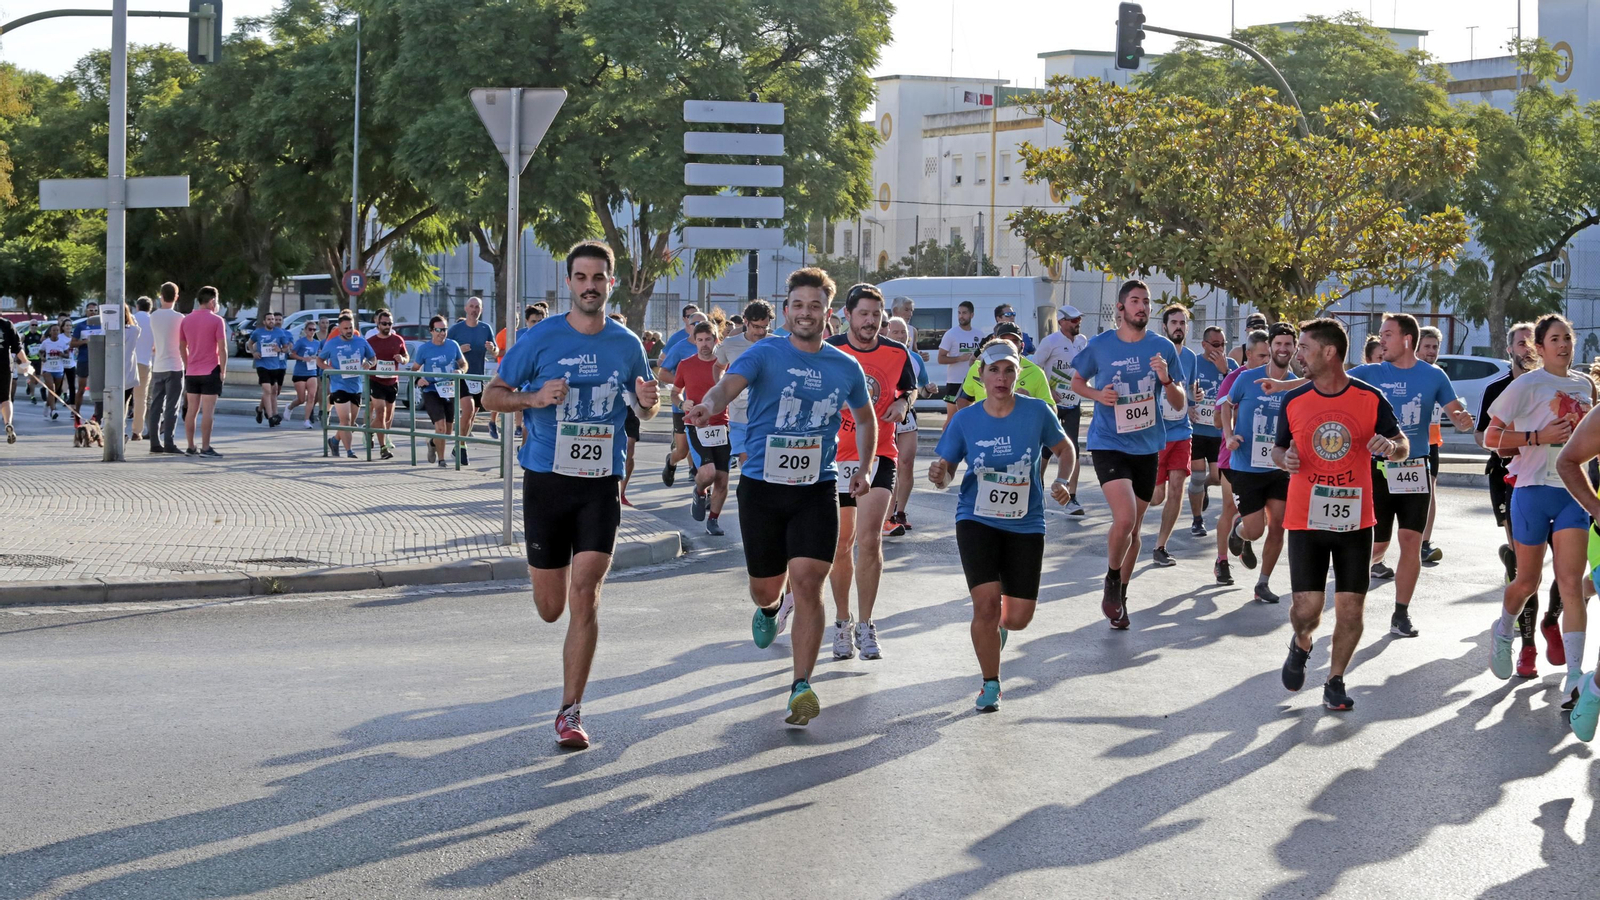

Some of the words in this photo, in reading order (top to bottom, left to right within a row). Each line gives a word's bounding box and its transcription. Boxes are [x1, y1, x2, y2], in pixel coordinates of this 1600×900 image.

[579, 354, 597, 364] XLI
[1126, 356, 1140, 364] XLI
[806, 368, 822, 379] XLI
[1061, 392, 1076, 400] 346
[1126, 406, 1148, 420] 804
[704, 429, 720, 439] 347
[1319, 424, 1342, 433] BEER
[994, 436, 1010, 445] XLI
[570, 444, 602, 460] 829
[1316, 442, 1350, 459] RUNNERS
[779, 455, 810, 469] 209
[1308, 470, 1355, 486] JEREZ
[1396, 472, 1419, 482] 446
[990, 490, 1018, 504] 679
[1322, 504, 1350, 518] 135
[1522, 607, 1534, 639] Kalenji
